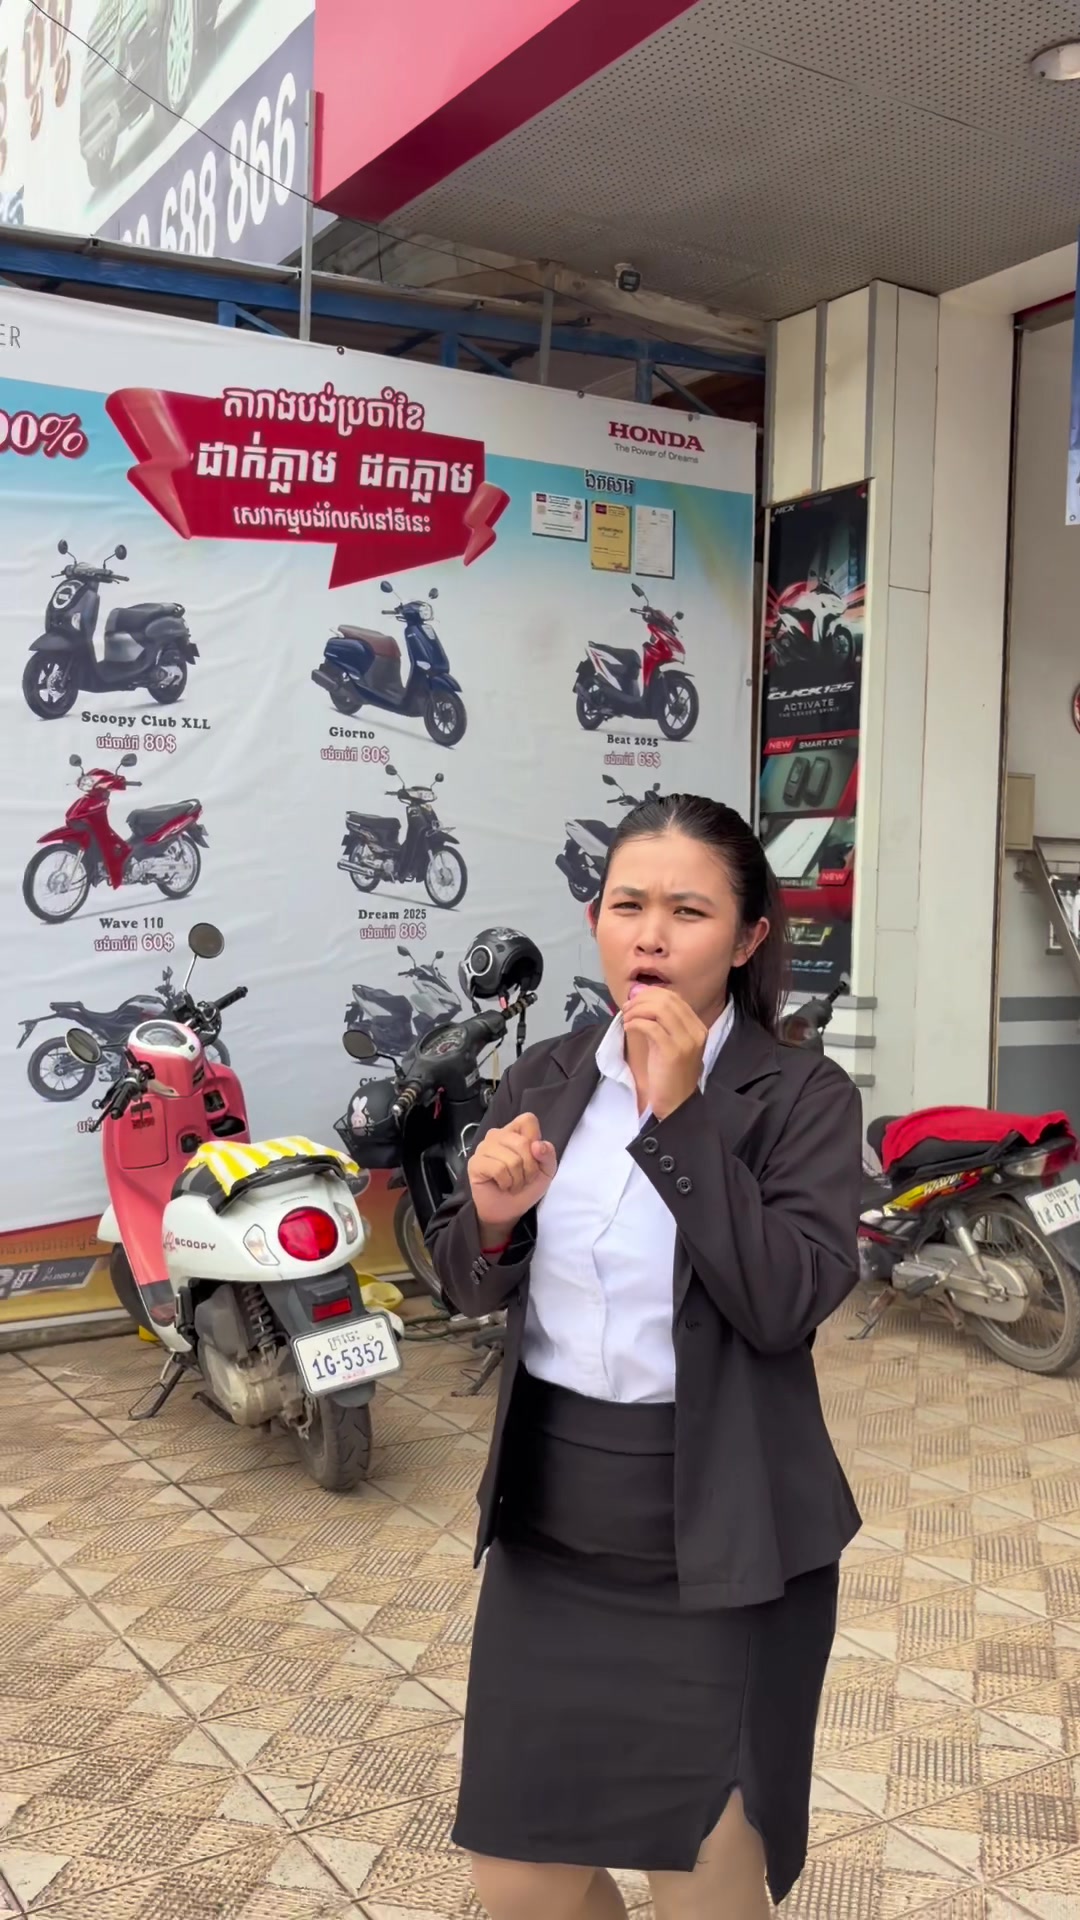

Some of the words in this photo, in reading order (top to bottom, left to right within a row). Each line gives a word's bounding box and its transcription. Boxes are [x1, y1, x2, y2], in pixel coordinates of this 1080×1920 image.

[227, 72, 296, 243] 866
[608, 421, 705, 452] HONDA
[614, 443, 630, 453] The
[631, 446, 657, 457] Power
[658, 450, 666, 459] of
[668, 451, 699, 463] Dreams
[196, 432, 338, 493] ដាក់ភ្លាម
[360, 453, 474, 503] ដកភ្លាម
[783, 698, 834, 712] ACTIVATE
[81, 711, 136, 727] Scoopy
[141, 715, 177, 728] Club
[181, 717, 211, 730] XLL
[329, 726, 375, 739] Giorno
[606, 734, 631, 745] Beat
[635, 736, 659, 747] 2025
[143, 733, 177, 754] 80$
[769, 741, 791, 750] NEW
[799, 740, 826, 749] SMART
[827, 738, 844, 746] KEY
[361, 745, 390, 765] 80$
[637, 751, 661, 768] 65$
[822, 872, 846, 881] NEW
[99, 917, 138, 930] Wave
[143, 917, 164, 930] 110
[358, 909, 399, 920] Dream
[403, 909, 427, 920] 2025
[399, 923, 427, 941] 80$
[141, 933, 175, 952] 60$
[175, 1237, 216, 1251] SCOOPY
[312, 1340, 388, 1380] 1G-5352
